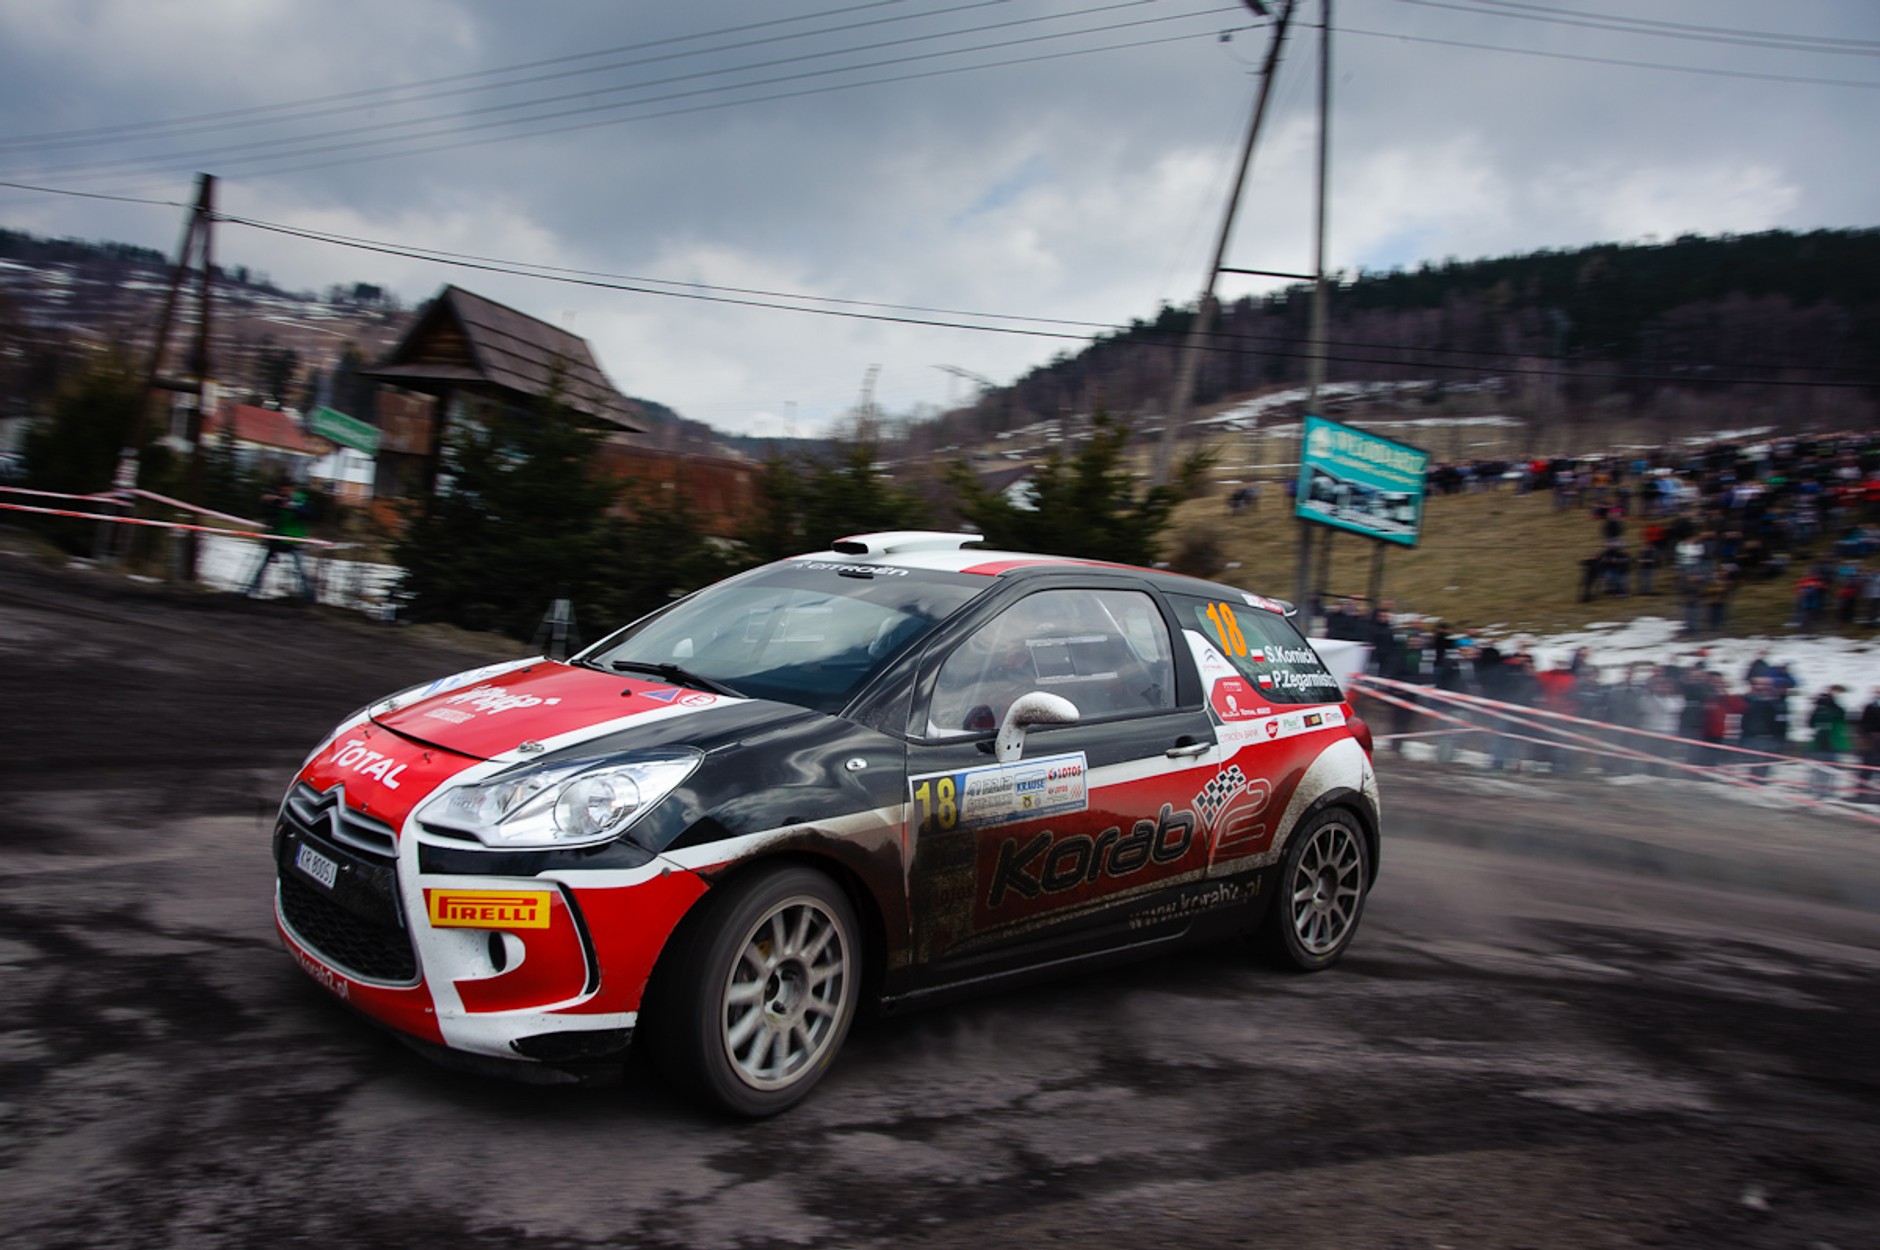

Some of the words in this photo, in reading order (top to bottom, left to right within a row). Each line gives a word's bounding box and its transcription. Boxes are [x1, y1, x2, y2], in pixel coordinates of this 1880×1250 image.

[1205, 602, 1248, 657] 18
[332, 739, 408, 790] TOTAL
[1057, 765, 1082, 780] LOTOS
[915, 777, 957, 832] 18
[1016, 779, 1045, 793] KRAUSE
[438, 895, 539, 921] PIRELLI
